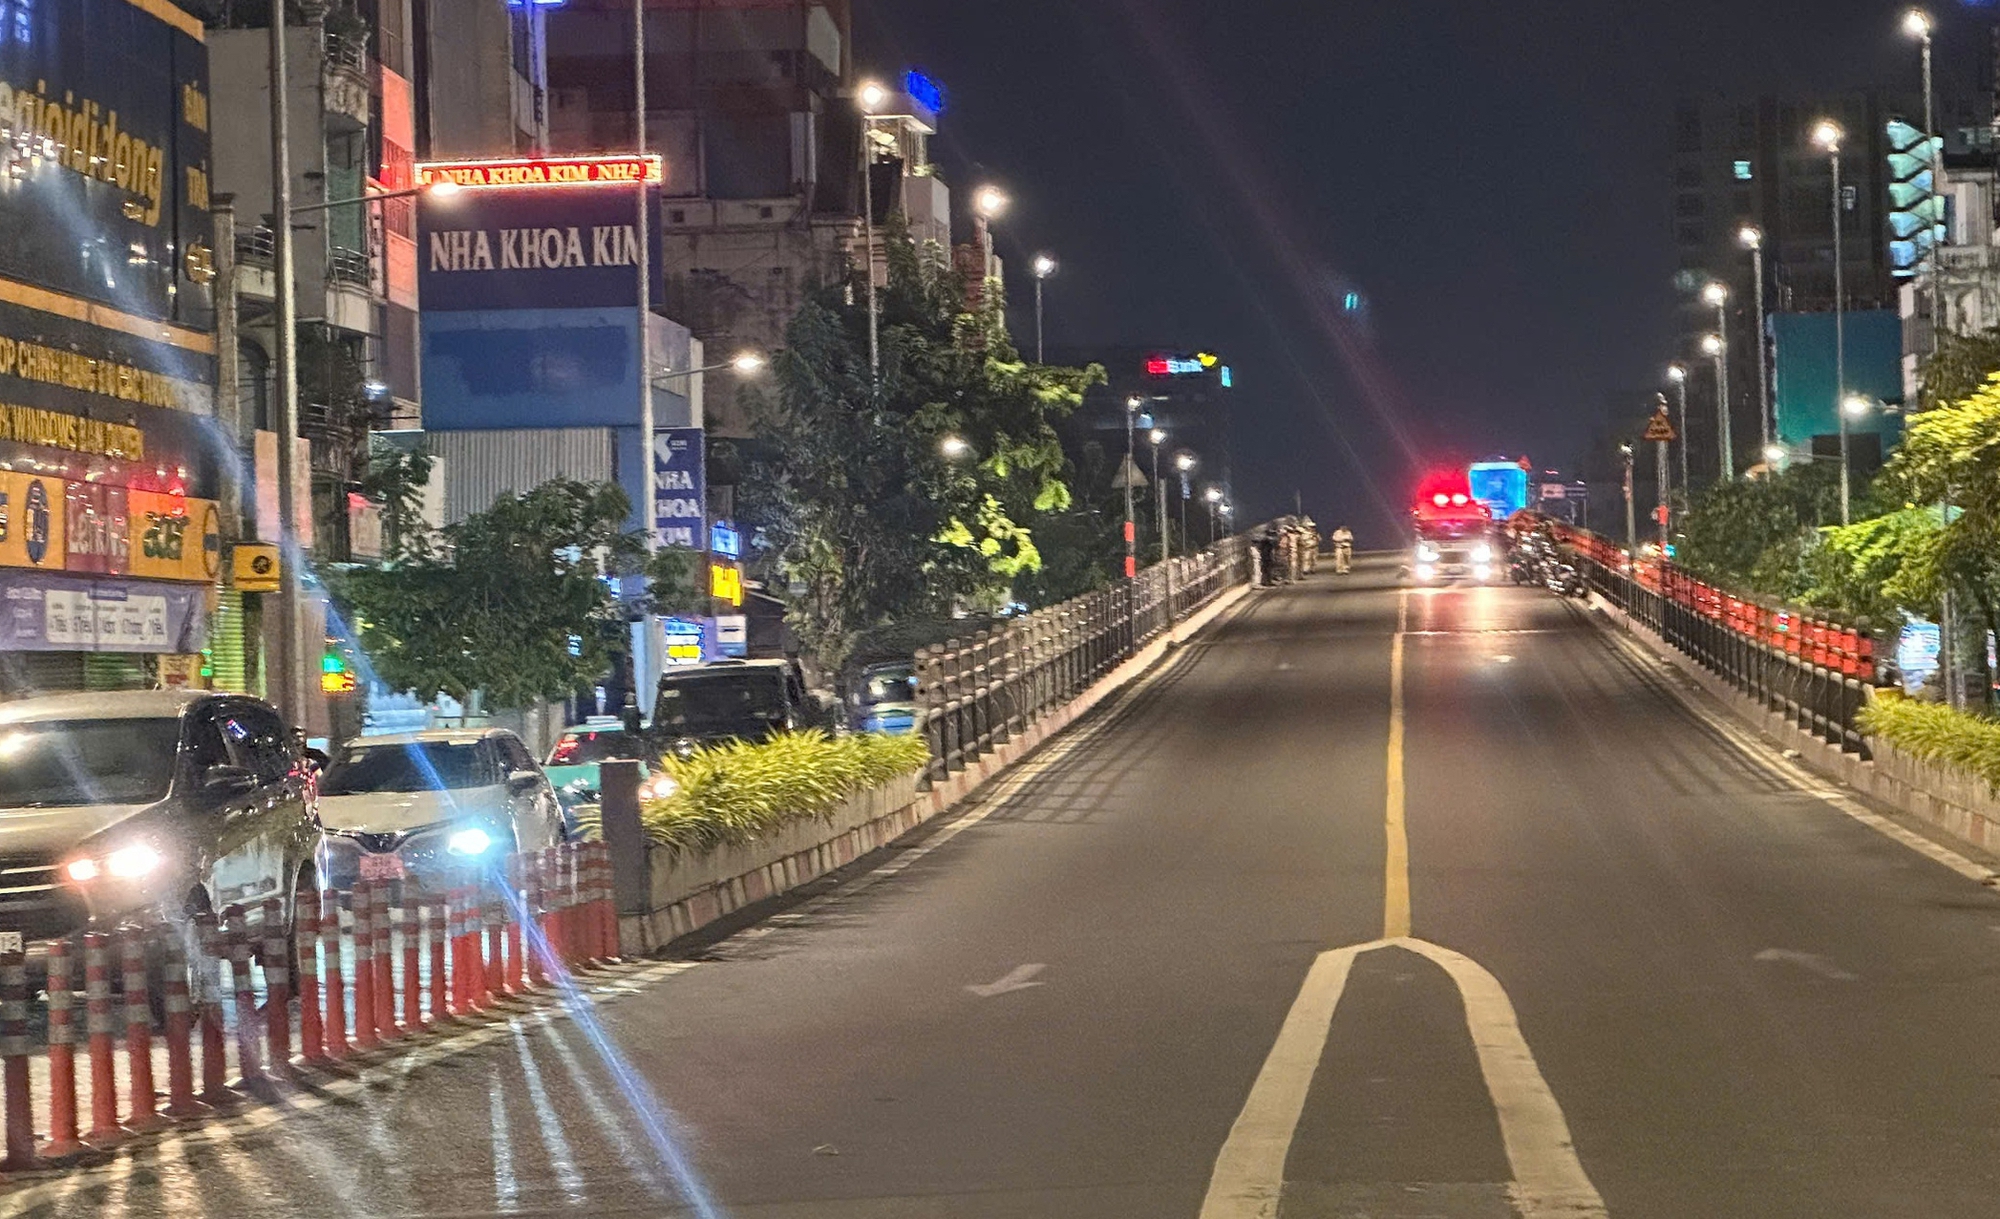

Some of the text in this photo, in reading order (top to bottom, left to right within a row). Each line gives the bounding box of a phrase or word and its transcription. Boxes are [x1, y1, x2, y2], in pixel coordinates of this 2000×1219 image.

[488, 166, 544, 184] KHOA
[548, 164, 590, 182] KIM
[430, 230, 495, 272] NHA
[500, 226, 587, 270] KHOA
[13, 403, 77, 449] WINDOWS
